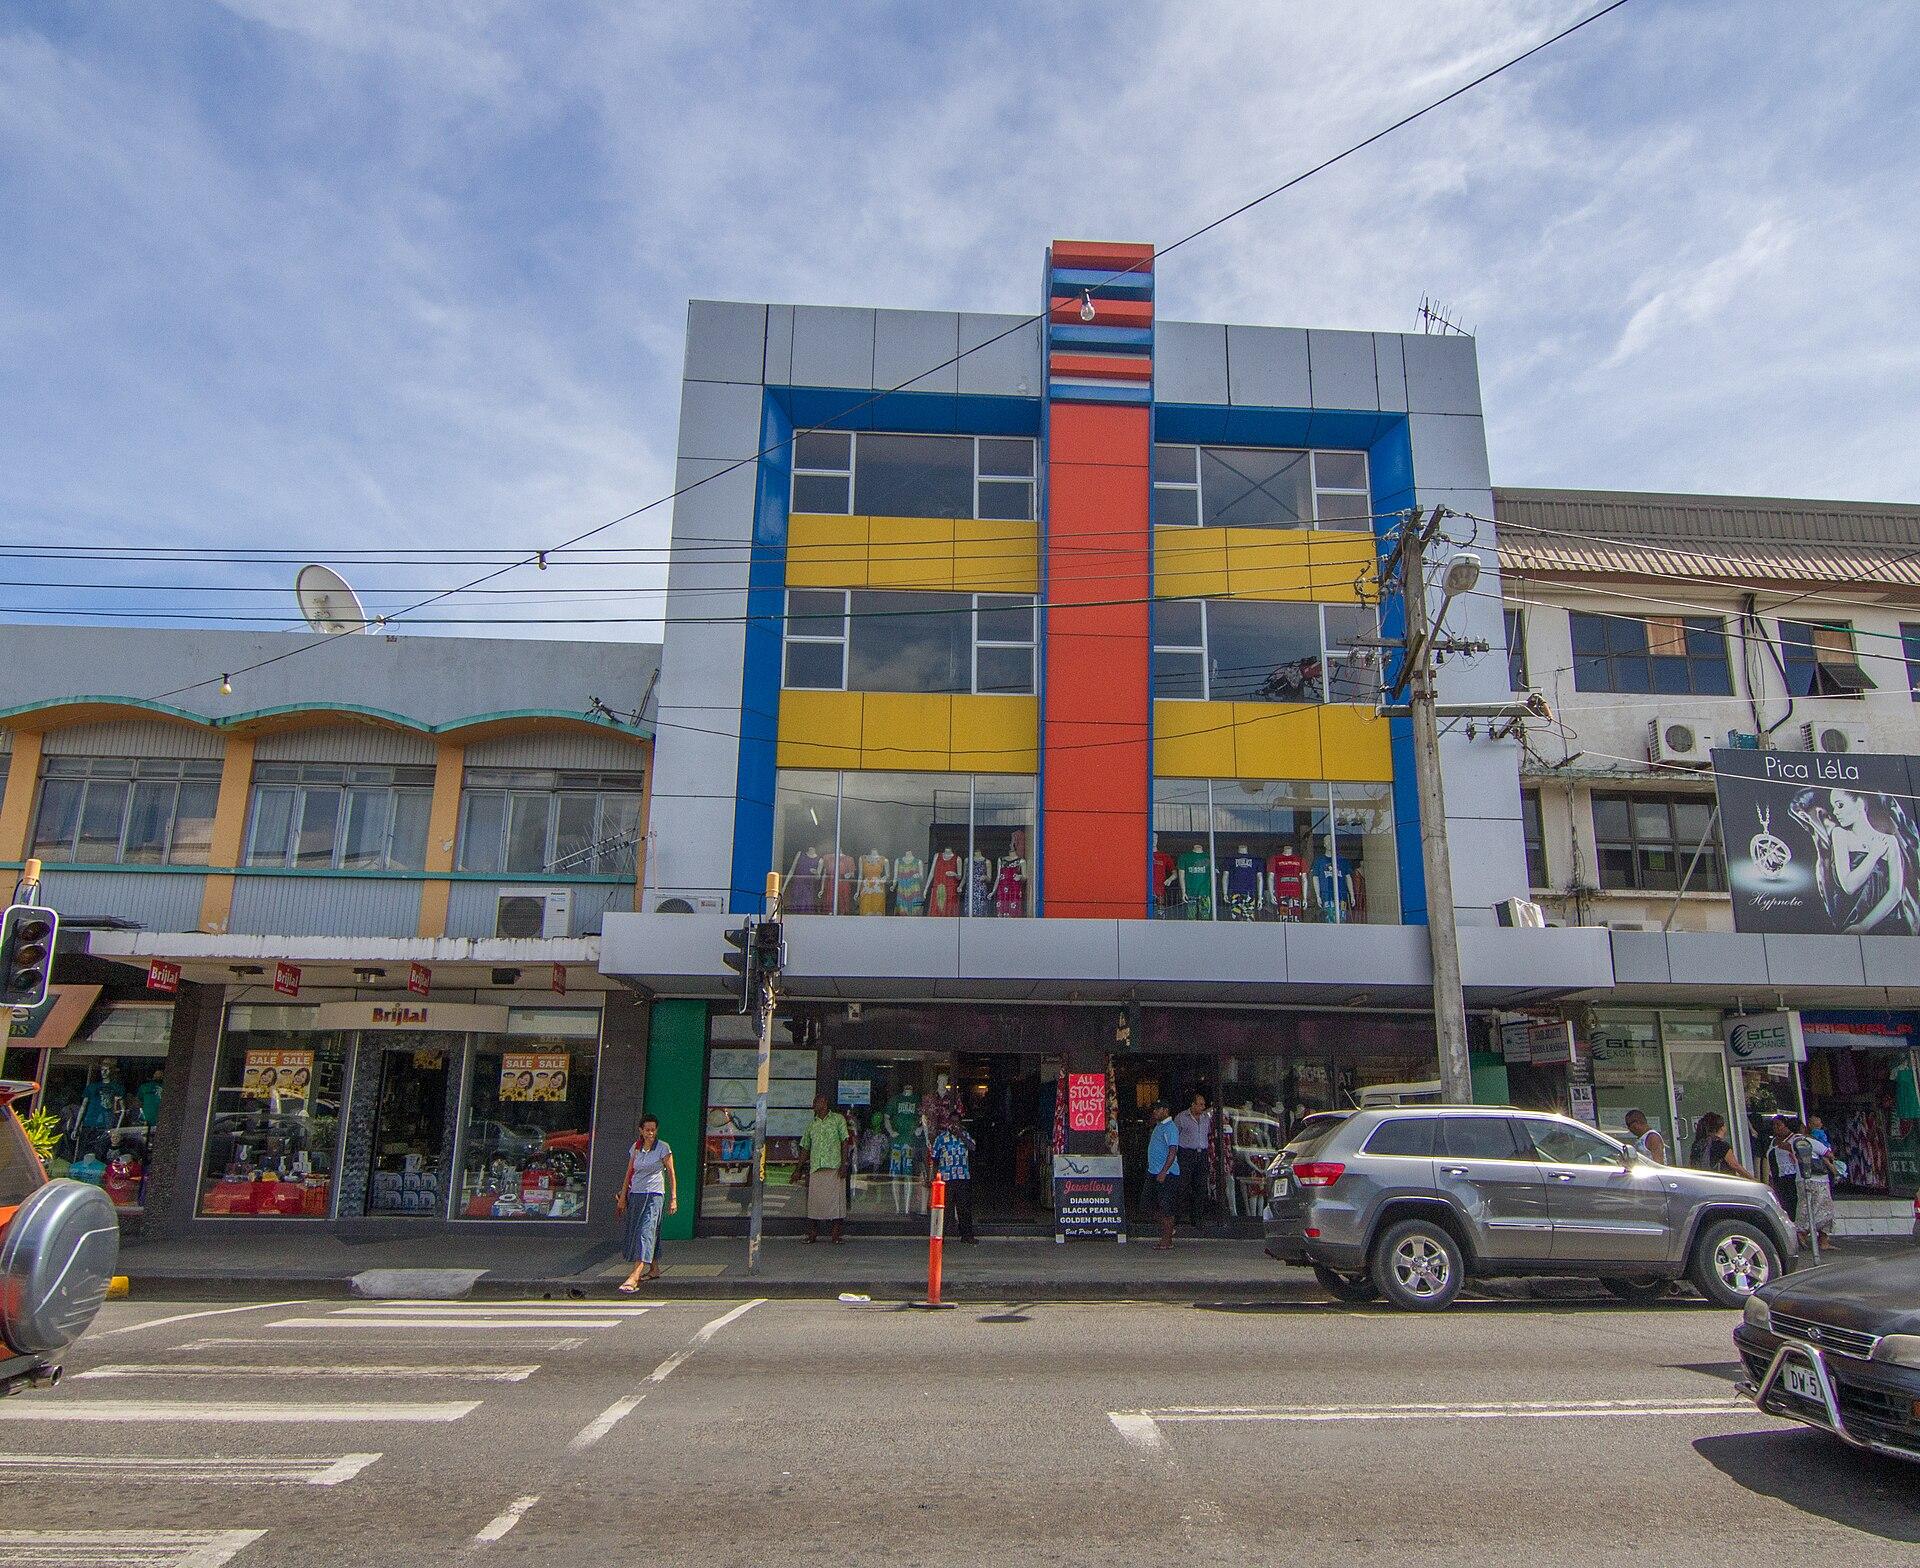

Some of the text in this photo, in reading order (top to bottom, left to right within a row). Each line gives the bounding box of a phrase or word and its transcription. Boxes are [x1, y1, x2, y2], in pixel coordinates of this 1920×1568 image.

[1765, 756, 1860, 780] Pica LéLa
[1748, 891, 1804, 911] Hypnotic
[1746, 1026, 1786, 1040] GCC
[1747, 1039, 1787, 1049] EXCHANGE
[249, 1056, 277, 1065] SALE
[283, 1056, 310, 1065] SALE
[506, 1060, 533, 1068] SALE
[539, 1060, 565, 1068] SALE
[1077, 1074, 1095, 1085] ALL
[1070, 1085, 1105, 1099] STOCK
[1071, 1099, 1104, 1112] MUST
[1075, 1112, 1103, 1126] GO!
[1063, 1180, 1114, 1195] Jewellery
